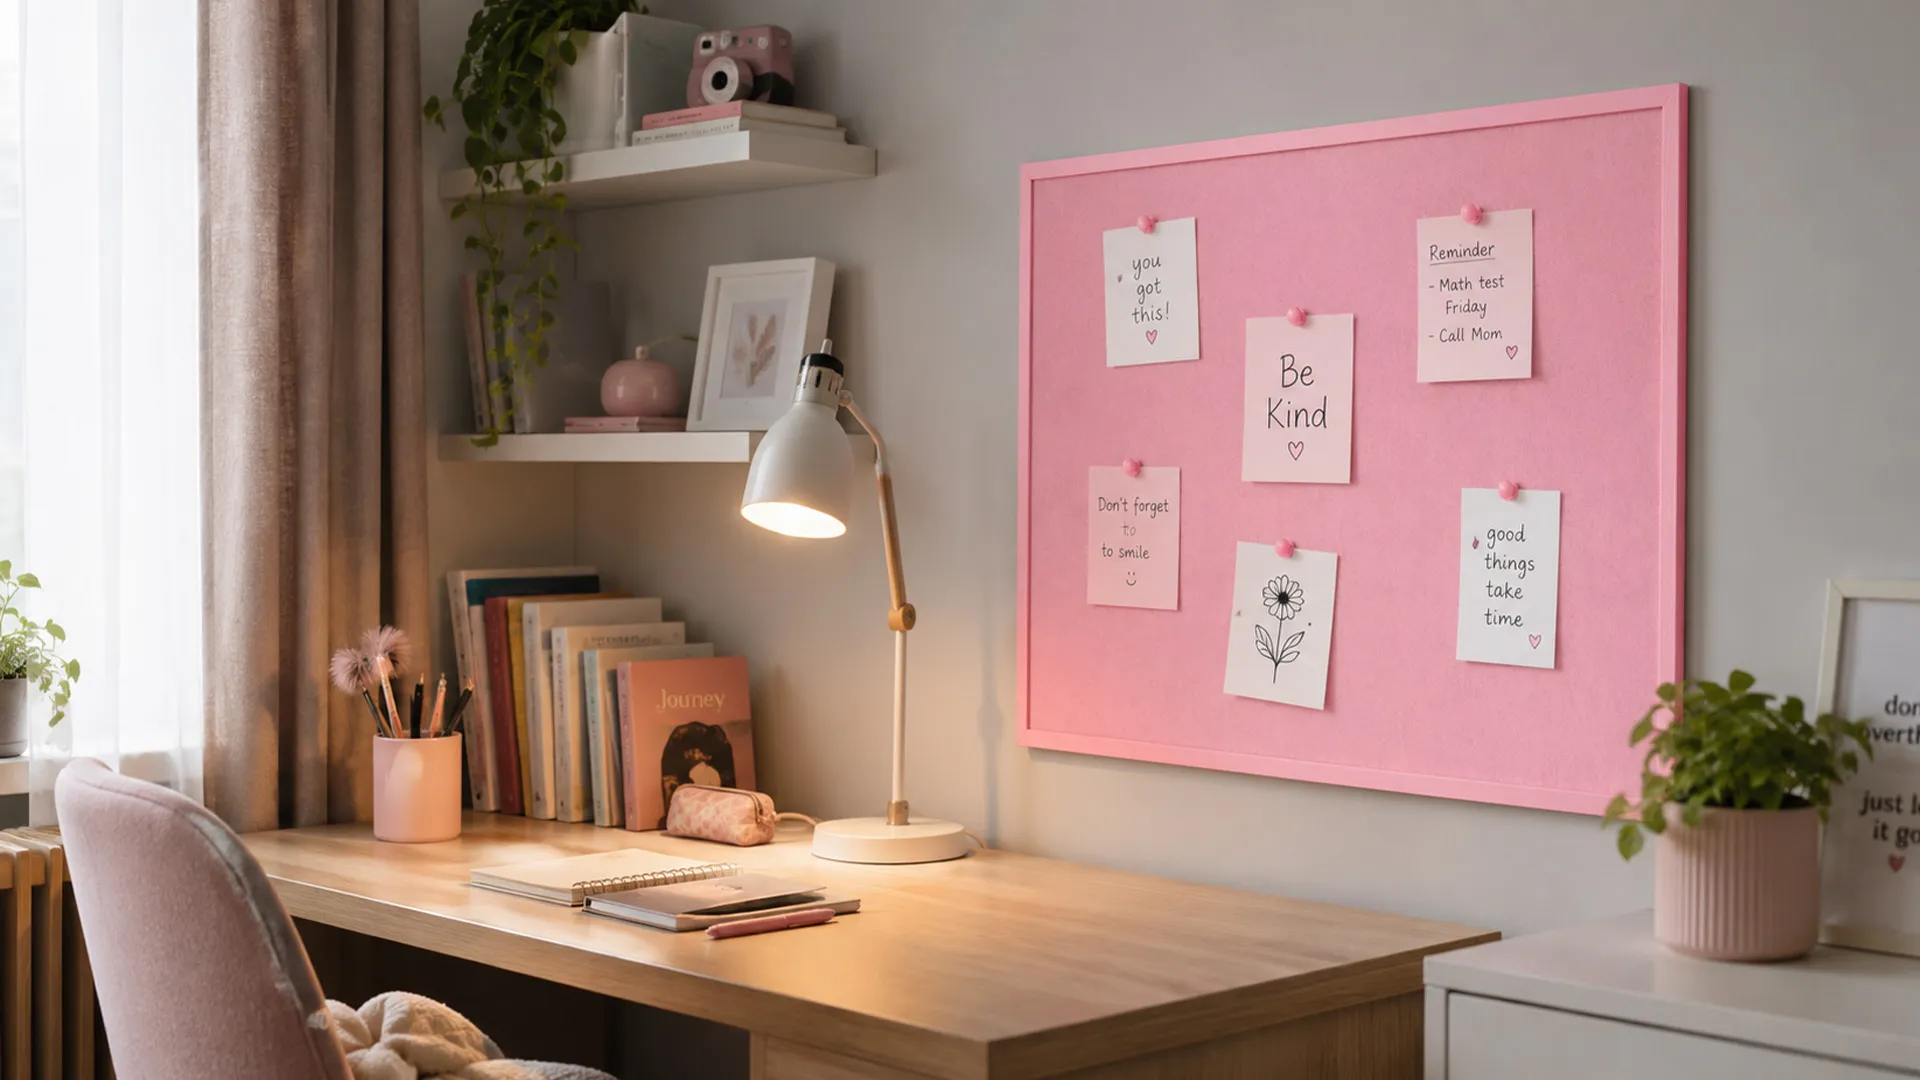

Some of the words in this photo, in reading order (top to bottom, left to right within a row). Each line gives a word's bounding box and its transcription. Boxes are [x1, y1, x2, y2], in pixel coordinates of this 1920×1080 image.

[1429, 241, 1495, 261] Reminder
[1132, 256, 1160, 280] you
[1136, 277, 1162, 305] got
[1439, 276, 1473, 292] Math
[1479, 275, 1505, 290] test
[1131, 301, 1169, 324] this!
[1445, 298, 1487, 320] Friday
[1439, 327, 1465, 343] Call
[1471, 327, 1503, 341] Mom
[1280, 353, 1315, 388] Be
[1267, 395, 1327, 428] Kind
[1098, 496, 1128, 512] Don't
[1133, 496, 1169, 519] forget
[1486, 524, 1526, 549] good
[1101, 542, 1114, 557] to
[1119, 545, 1150, 560] smile
[1484, 552, 1535, 580] things
[1486, 580, 1524, 600] take
[1484, 608, 1524, 627] time
[1858, 790, 1903, 817] just
[1873, 819, 1889, 842] it
[1895, 826, 1920, 850] go
